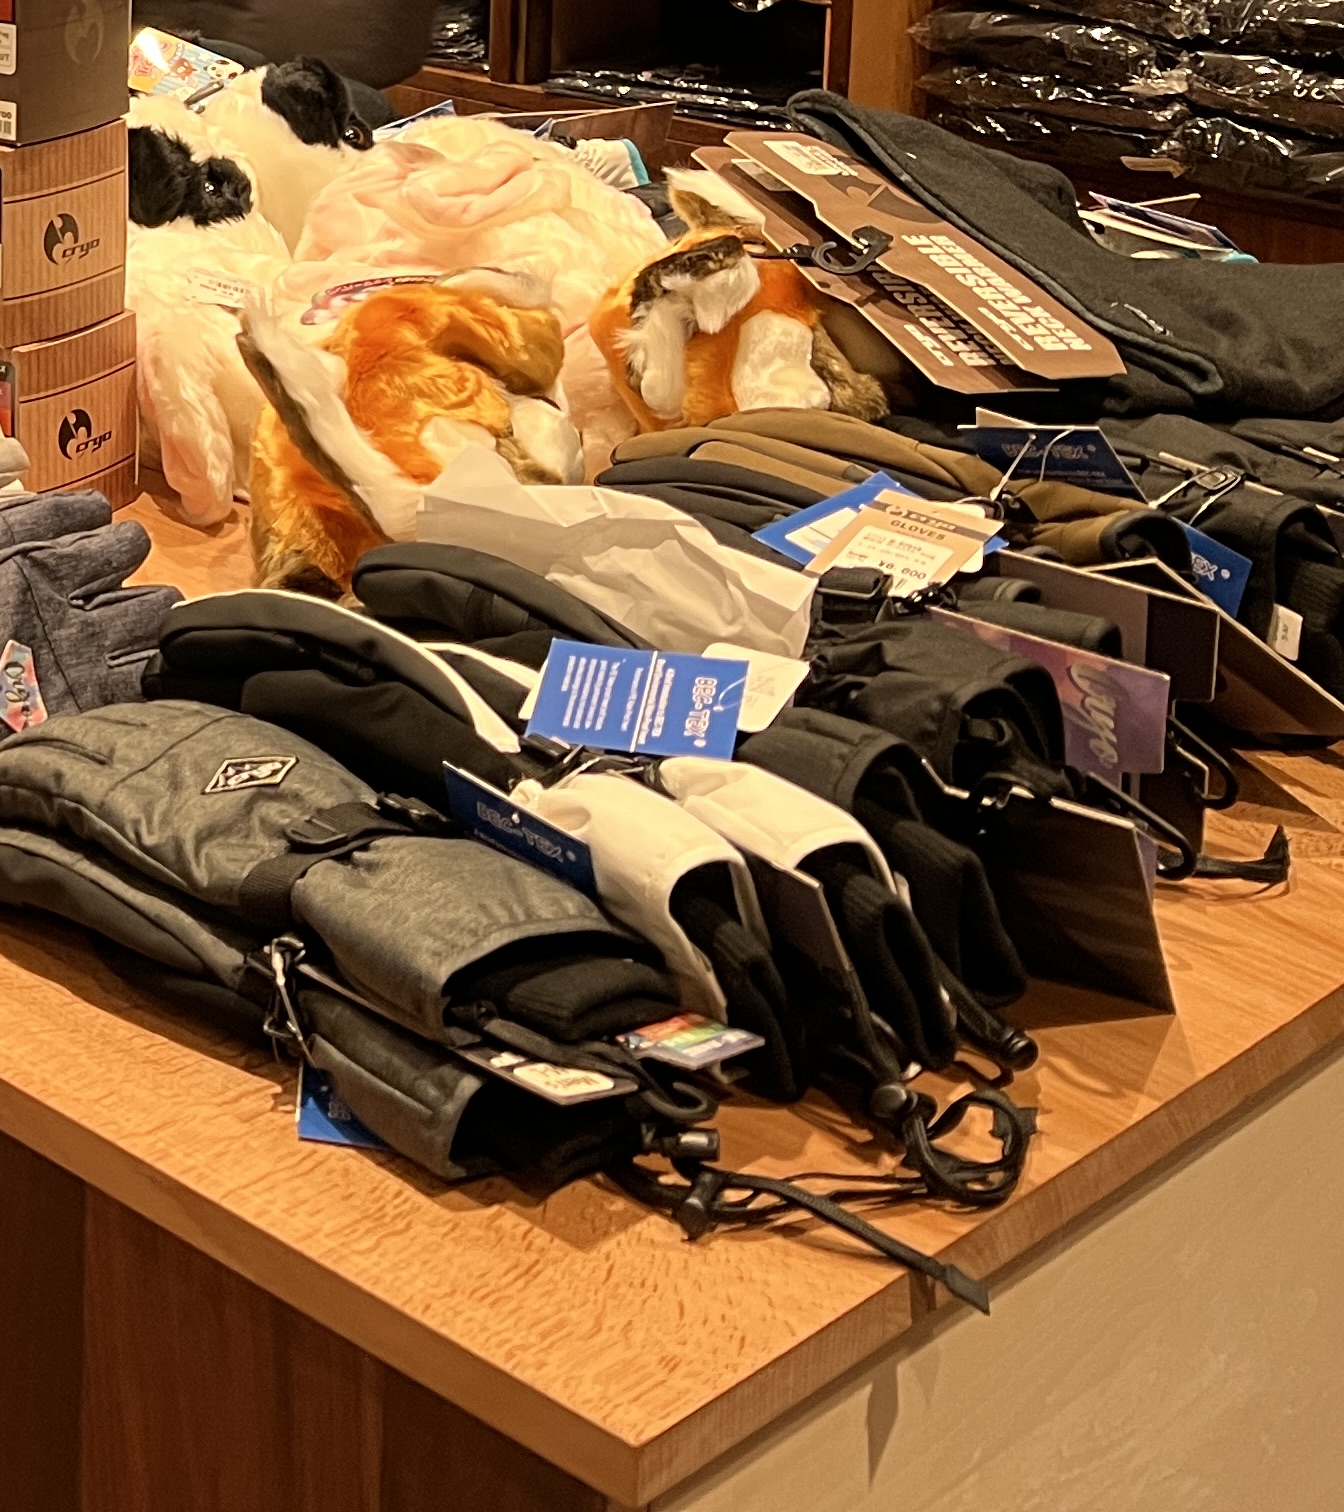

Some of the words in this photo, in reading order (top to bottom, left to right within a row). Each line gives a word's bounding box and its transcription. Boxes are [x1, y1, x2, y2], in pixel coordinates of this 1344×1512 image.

[61, 238, 101, 260] cryo
[929, 235, 1032, 304] WARMER
[902, 234, 1069, 351] REVERSIBLE
[1023, 305, 1093, 351] NECK
[75, 430, 113, 453] cryo
[890, 519, 947, 541] GLOVES
[683, 677, 718, 737] BEC-TEX
